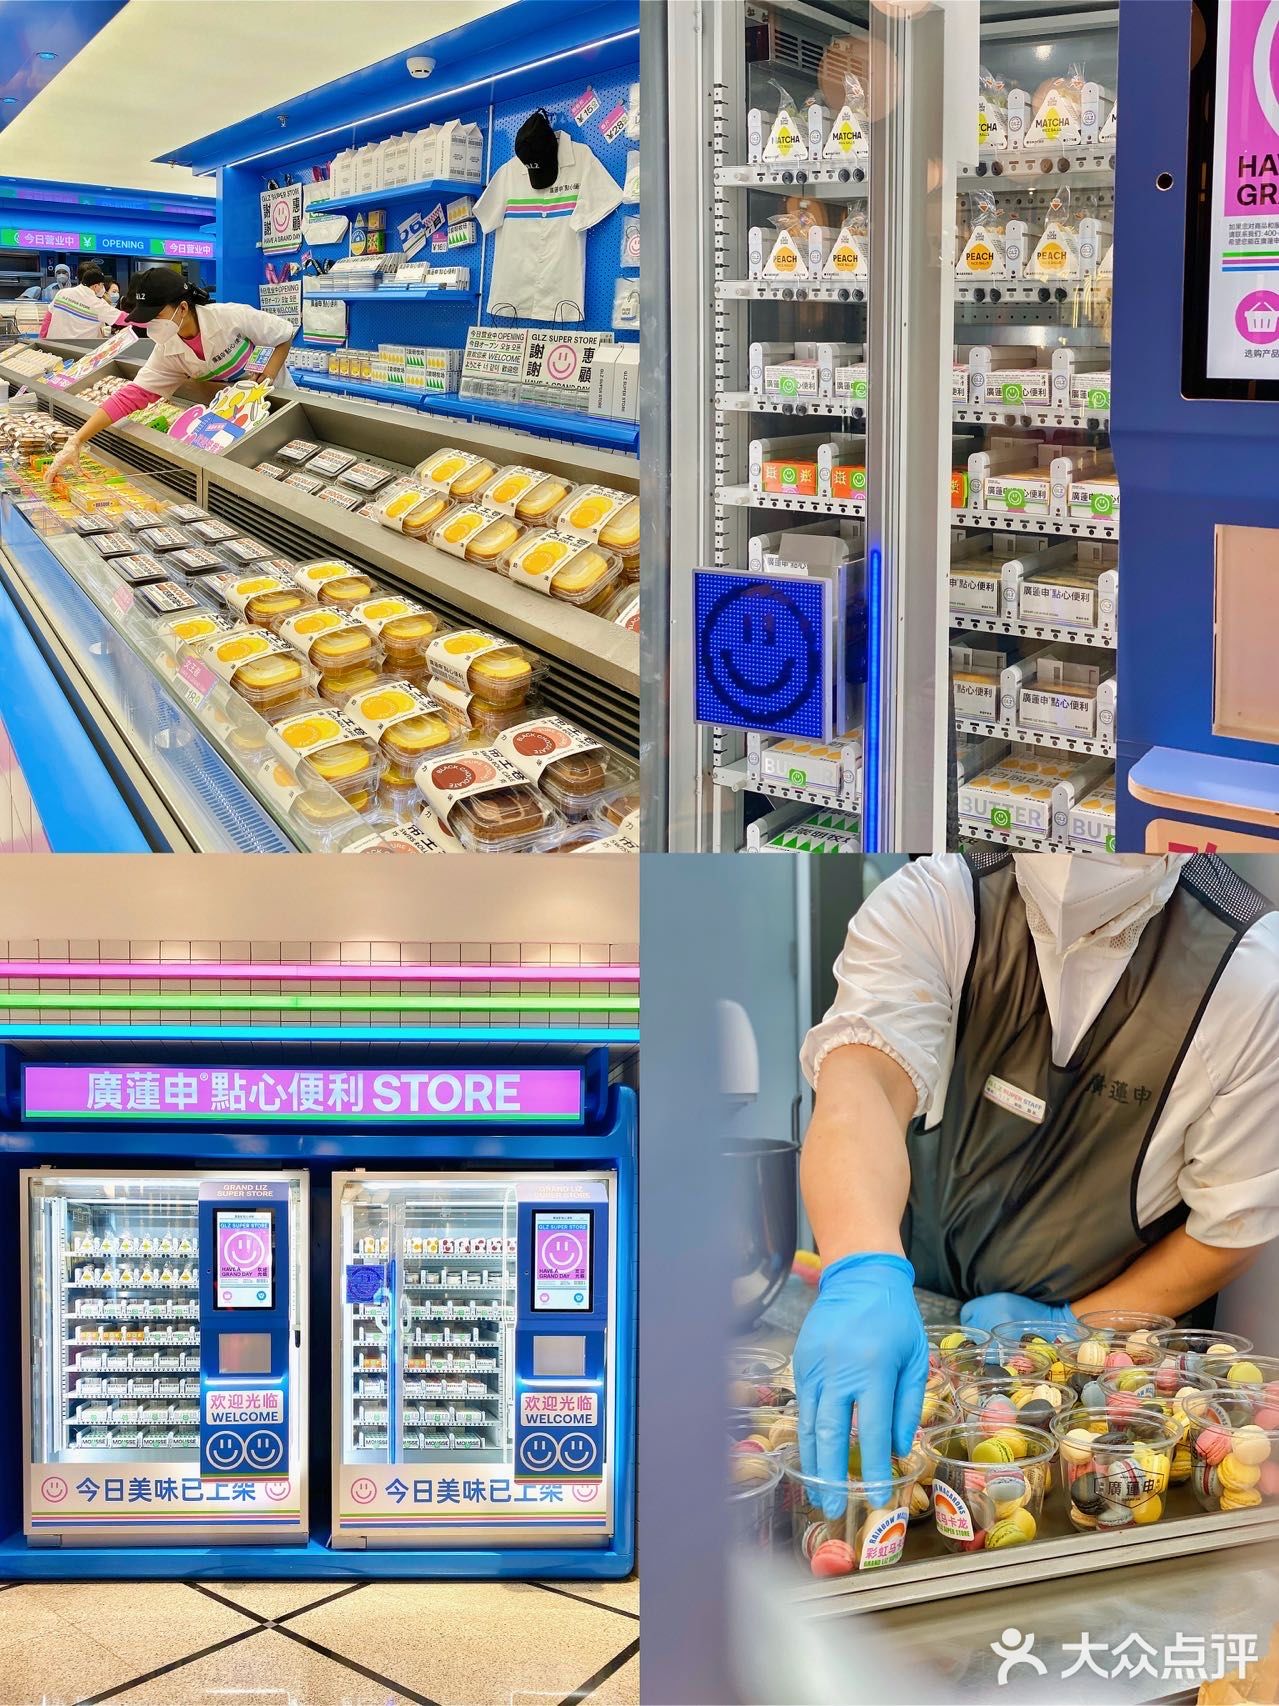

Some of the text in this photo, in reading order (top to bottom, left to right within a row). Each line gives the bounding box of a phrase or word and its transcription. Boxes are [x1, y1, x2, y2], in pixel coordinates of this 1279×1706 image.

[1035, 117, 1070, 129] MATCHA
[832, 131, 862, 141] MATCHA
[1238, 153, 1279, 178] HA
[1237, 183, 1279, 206] GR
[24, 233, 74, 247] 今日营业中
[102, 239, 144, 249] OPENING
[169, 242, 211, 254] 今日营业中
[773, 255, 798, 263] PEACH
[832, 254, 858, 263] PEACH
[966, 252, 994, 260] PEACH
[1036, 251, 1067, 260] PEACH
[498, 333, 525, 341] OPENING
[531, 334, 598, 345] GLZ SUPER STORE
[488, 353, 522, 363] WELCOME
[518, 732, 536, 743] BLACK
[436, 764, 460, 775] BLACK
[399, 828, 416, 843] SWISS
[373, 1073, 521, 1112] STORE
[1023, 1098, 1042, 1110] STAFF
[210, 1393, 279, 1411] 欢迎光临
[524, 1395, 593, 1412] 欢迎光临
[211, 1411, 279, 1424] WELCOME
[525, 1413, 593, 1424] WELCOME
[75, 1477, 256, 1503] 今日美味已上架
[384, 1478, 564, 1504] 今日美味已上架
[869, 1515, 896, 1545] RAINBOW
[955, 1528, 970, 1537] STORE
